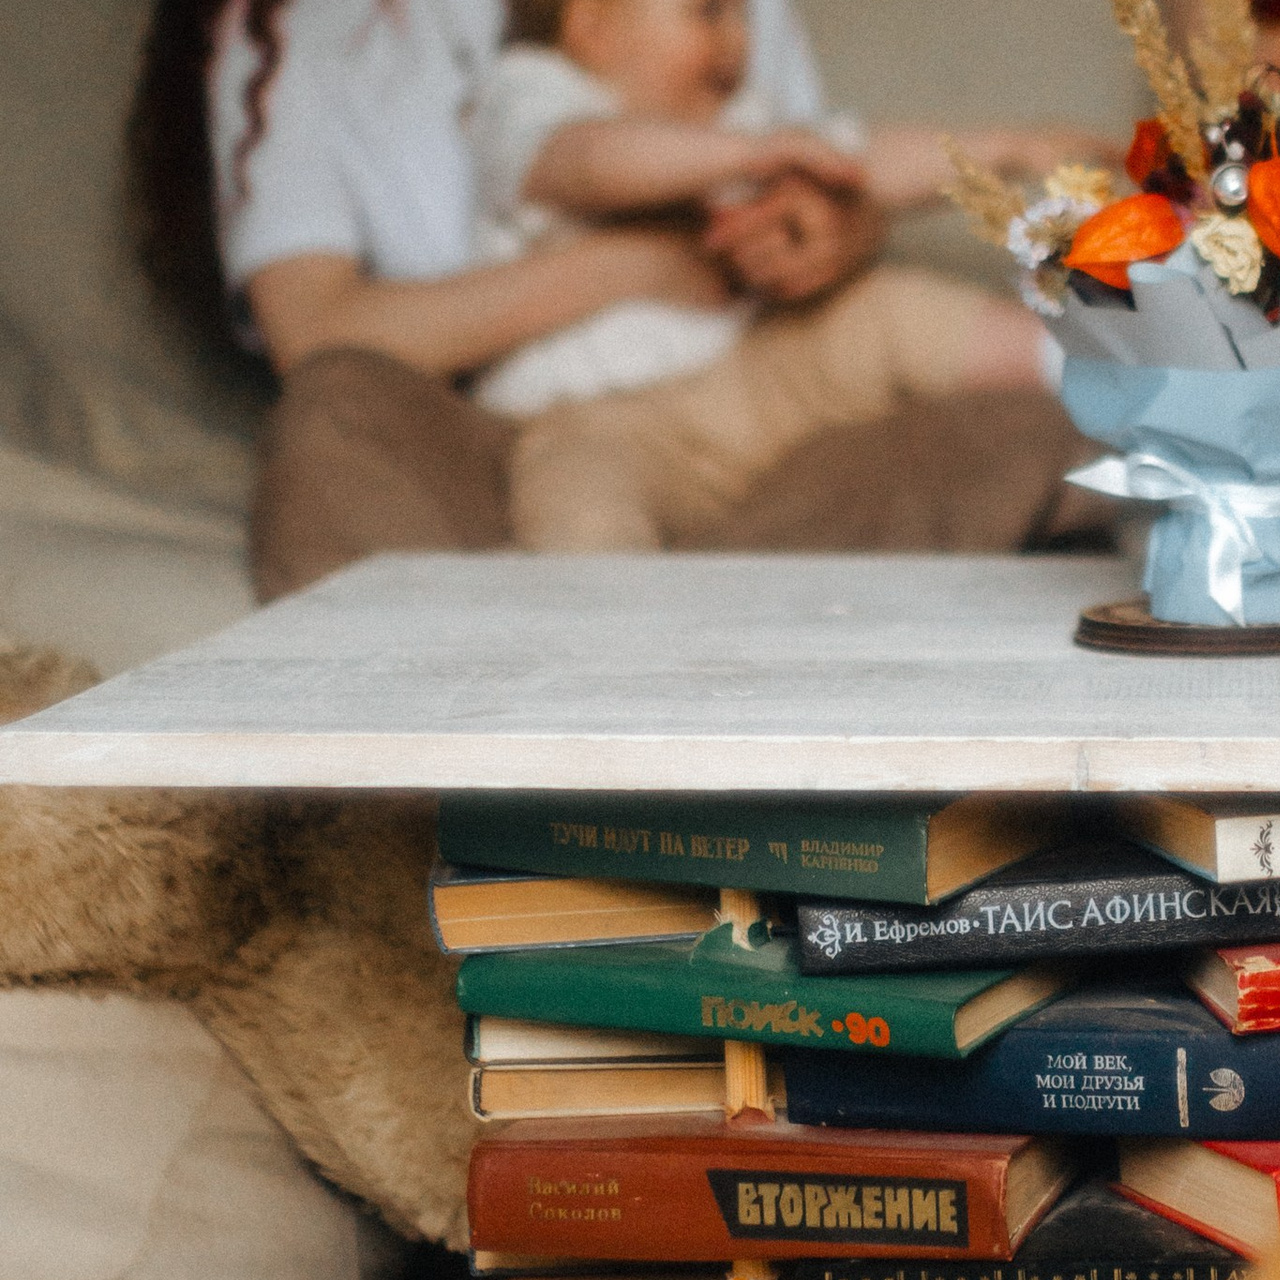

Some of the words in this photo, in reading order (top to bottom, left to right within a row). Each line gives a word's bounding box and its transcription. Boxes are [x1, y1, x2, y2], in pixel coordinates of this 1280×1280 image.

[550, 822, 598, 848] ТУЧИ
[603, 826, 651, 853] ИДУТ
[690, 834, 750, 861] ВЕТЕР
[801, 840, 884, 858] ВЛАДИМИР
[801, 855, 879, 872] КАРПЕНКО
[845, 923, 867, 943] И.
[873, 919, 970, 947] Ефремов
[980, 900, 1073, 935] ТАИС
[1082, 885, 1275, 928] АФИНСКАЯ
[701, 996, 824, 1038] ПОИСК
[1047, 1052, 1087, 1070] МОЙ
[1093, 1055, 1132, 1072] ВЕК,
[1036, 1074, 1075, 1090] МОИ
[1081, 1075, 1145, 1091] ДРУЗЬЯ
[1042, 1094, 1057, 1108] И
[1061, 1095, 1140, 1111] ПОДРУГИ
[527, 1176, 620, 1195] Василий
[528, 1202, 622, 1221] Соколов
[738, 1182, 958, 1233] ВТОРЖЕНИЕ
